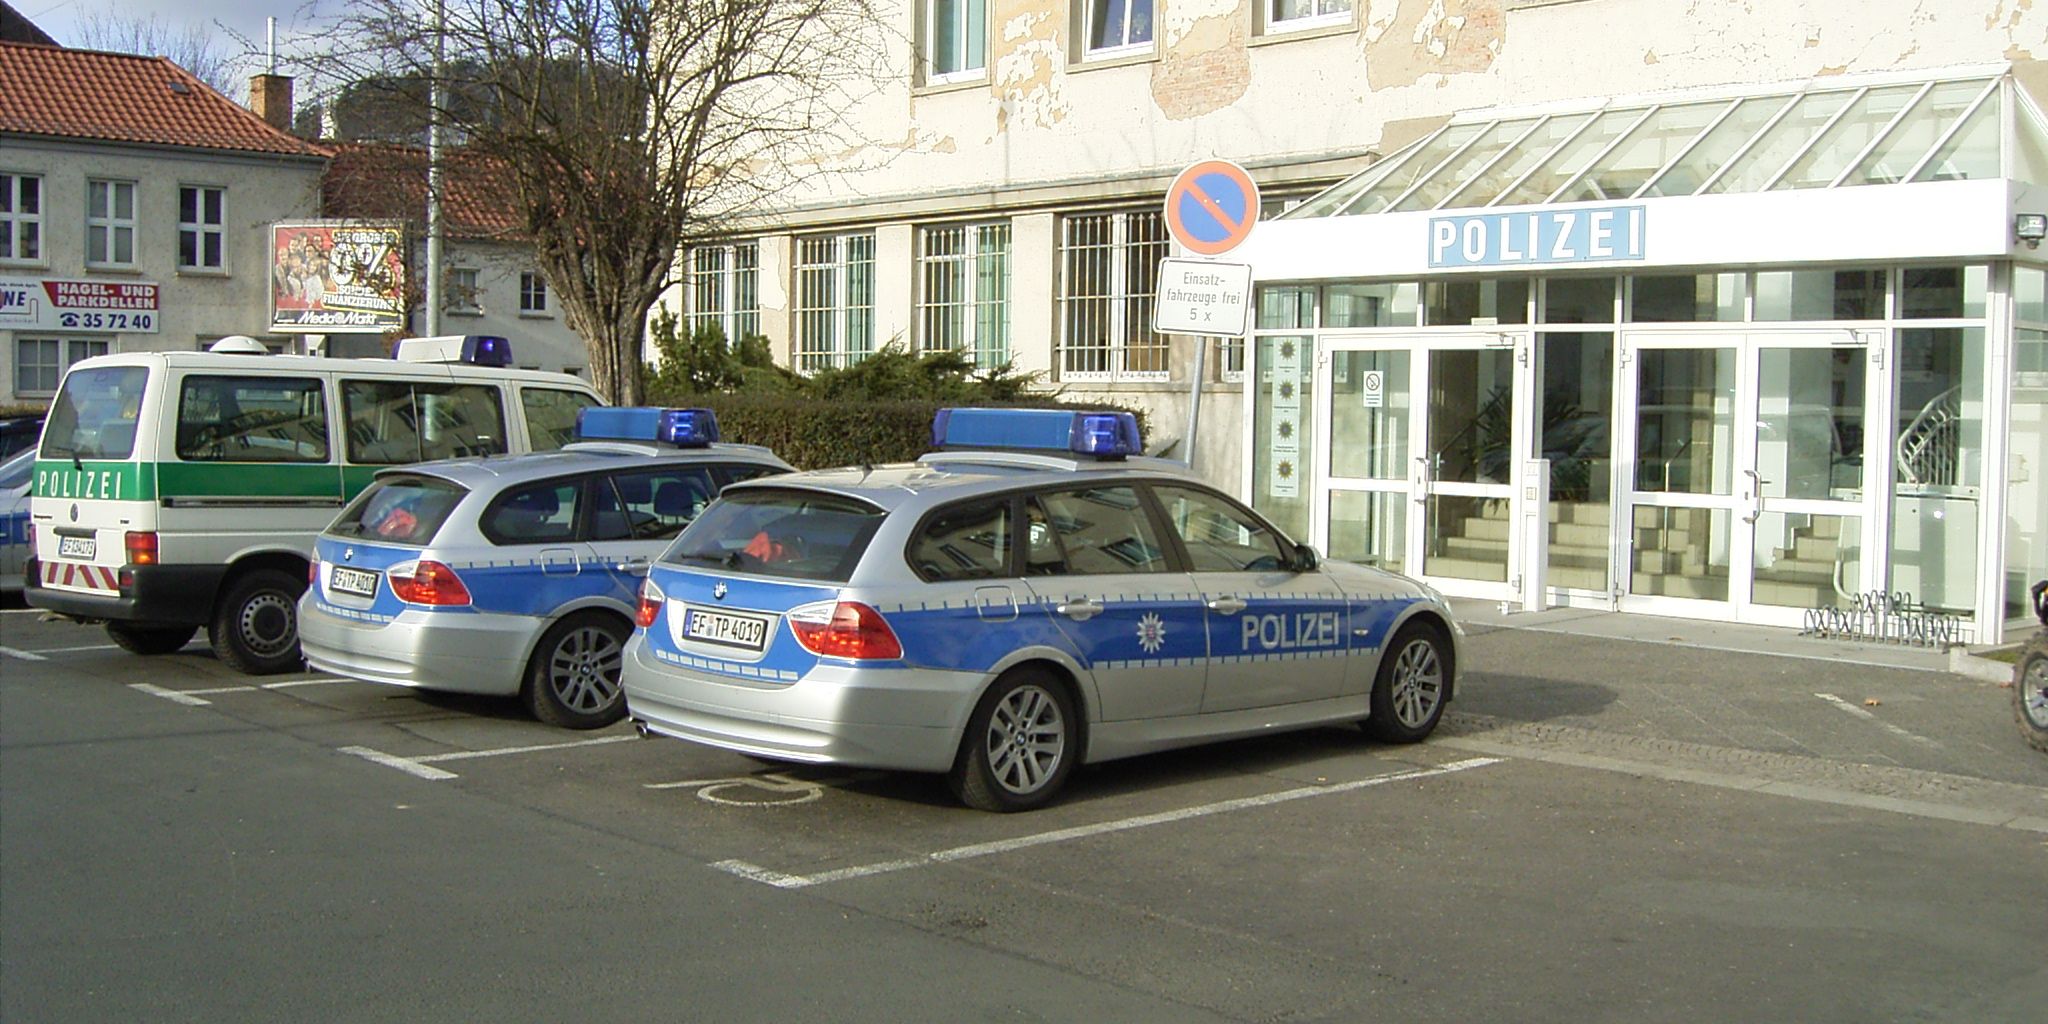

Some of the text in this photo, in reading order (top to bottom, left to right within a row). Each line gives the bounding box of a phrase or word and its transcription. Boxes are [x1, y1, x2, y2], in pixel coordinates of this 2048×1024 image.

[1433, 208, 1640, 264] POLIZEI
[1183, 271, 1226, 286] Einsatz-
[58, 283, 154, 297] HAGEL- UND
[1166, 288, 1241, 306] fahrzeuge frei
[58, 295, 154, 308] PARKDELLEN
[83, 313, 151, 329] 35 72 40
[1189, 307, 1212, 322] 5 x
[39, 470, 122, 500] POLIZEI
[691, 614, 762, 643] EF TP 4019
[1241, 611, 1340, 651] POLIZEI
